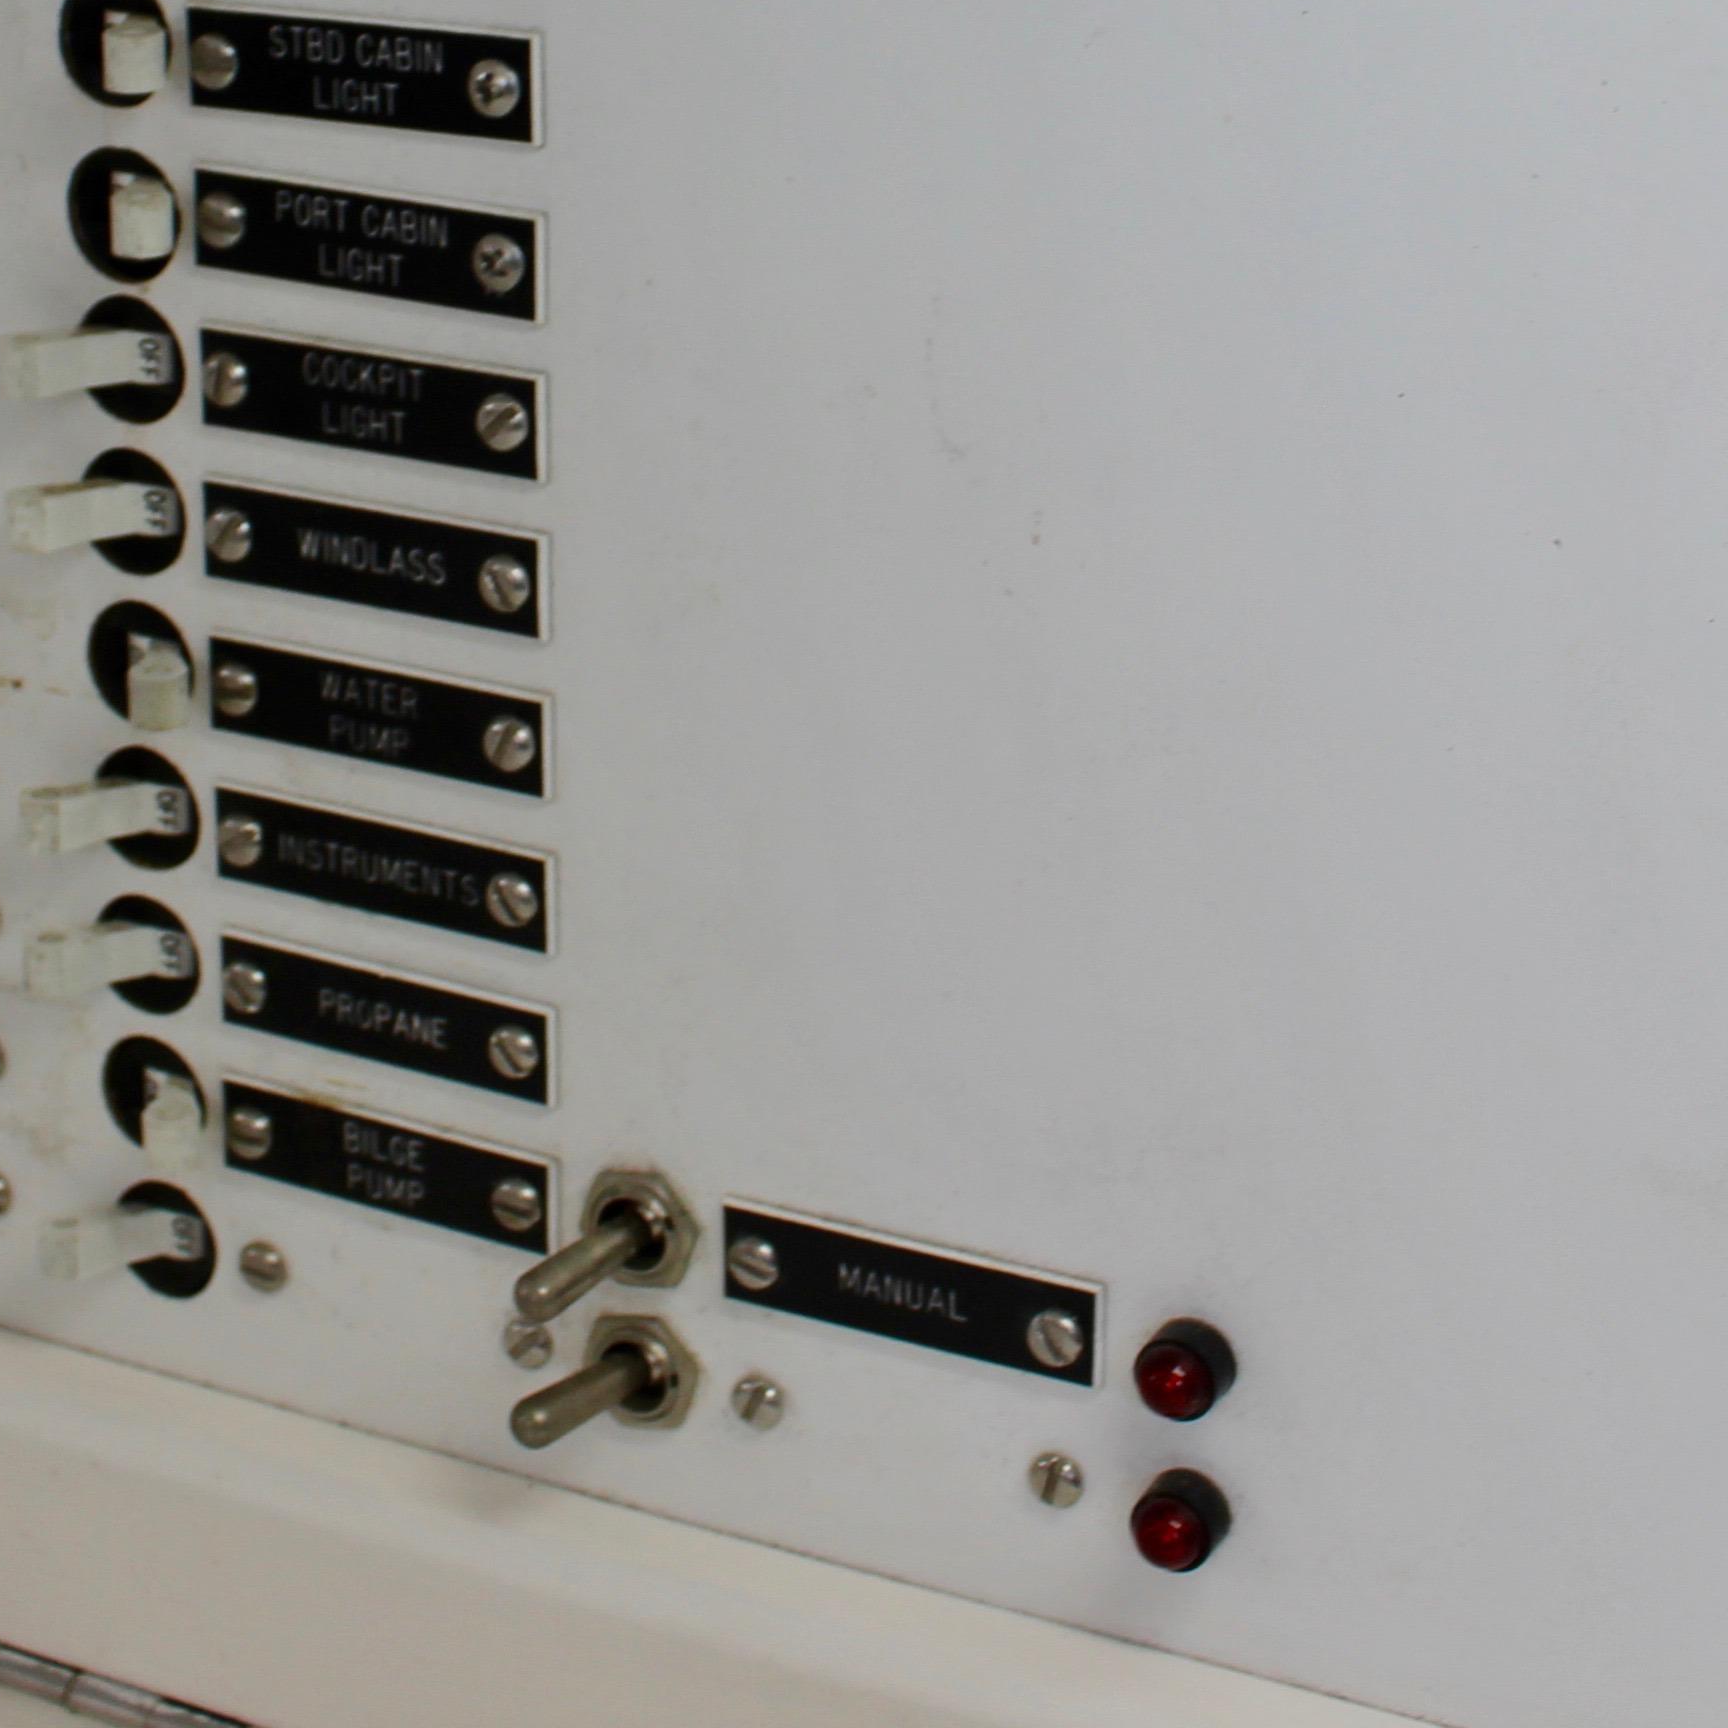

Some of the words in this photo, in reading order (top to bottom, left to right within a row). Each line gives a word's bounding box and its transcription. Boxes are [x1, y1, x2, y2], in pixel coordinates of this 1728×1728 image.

[268, 24, 346, 66] STBD
[354, 33, 445, 75] CABIN
[312, 75, 400, 118] LIGHT
[274, 189, 350, 236] PORT
[360, 204, 449, 248] CABIN
[316, 244, 406, 288] LIGHT
[301, 350, 425, 404] COCKPIT
[320, 400, 408, 445] LIGHT
[296, 527, 447, 588] WINDLASS
[319, 673, 420, 718] WATER
[328, 713, 411, 758] PUMP
[276, 832, 481, 908] INSTRUMENTS
[318, 987, 448, 1051] PROPANE
[342, 1118, 425, 1172] BILGE
[346, 1163, 425, 1208] PUMP
[837, 1261, 969, 1325] MANUAL
